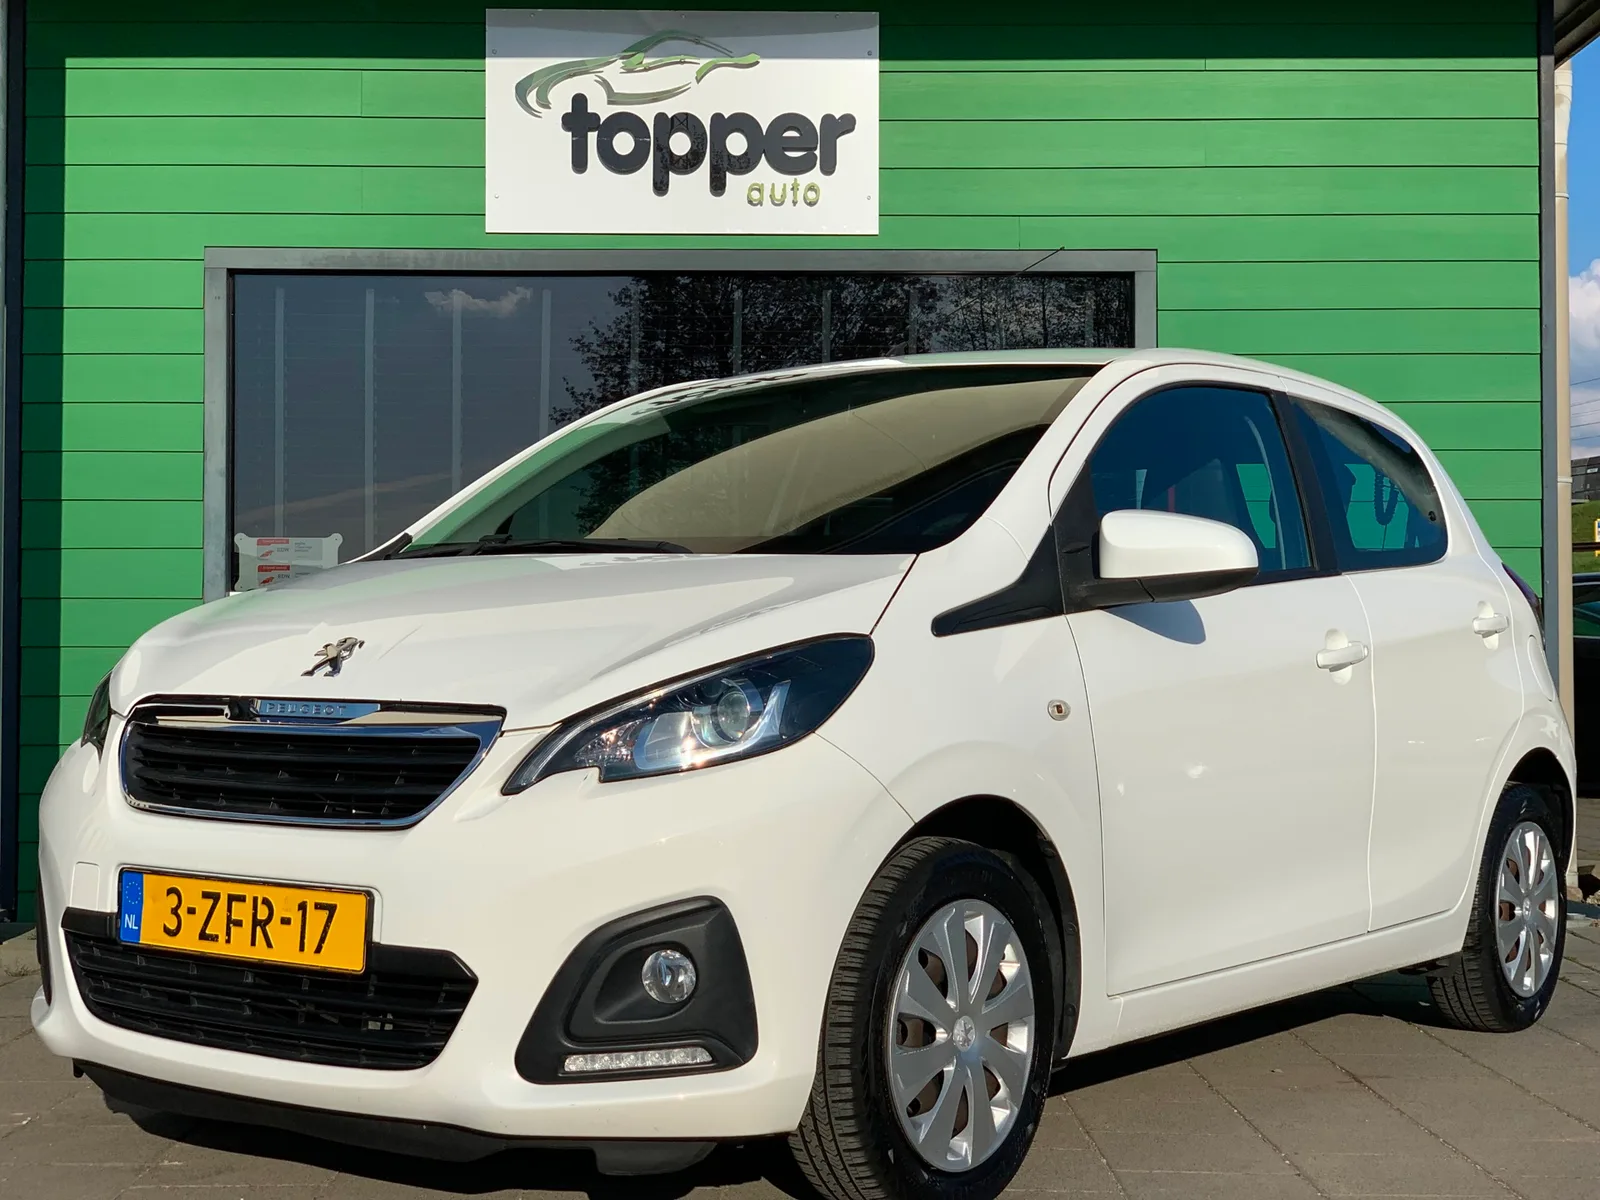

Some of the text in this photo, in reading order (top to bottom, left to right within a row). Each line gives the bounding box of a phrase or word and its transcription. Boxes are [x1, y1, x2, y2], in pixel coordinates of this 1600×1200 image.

[562, 92, 856, 196] topper
[747, 178, 820, 207] auto
[266, 702, 347, 716] PEUGEOT
[124, 914, 138, 930] NL
[163, 886, 338, 954] 3-ZFR-17
